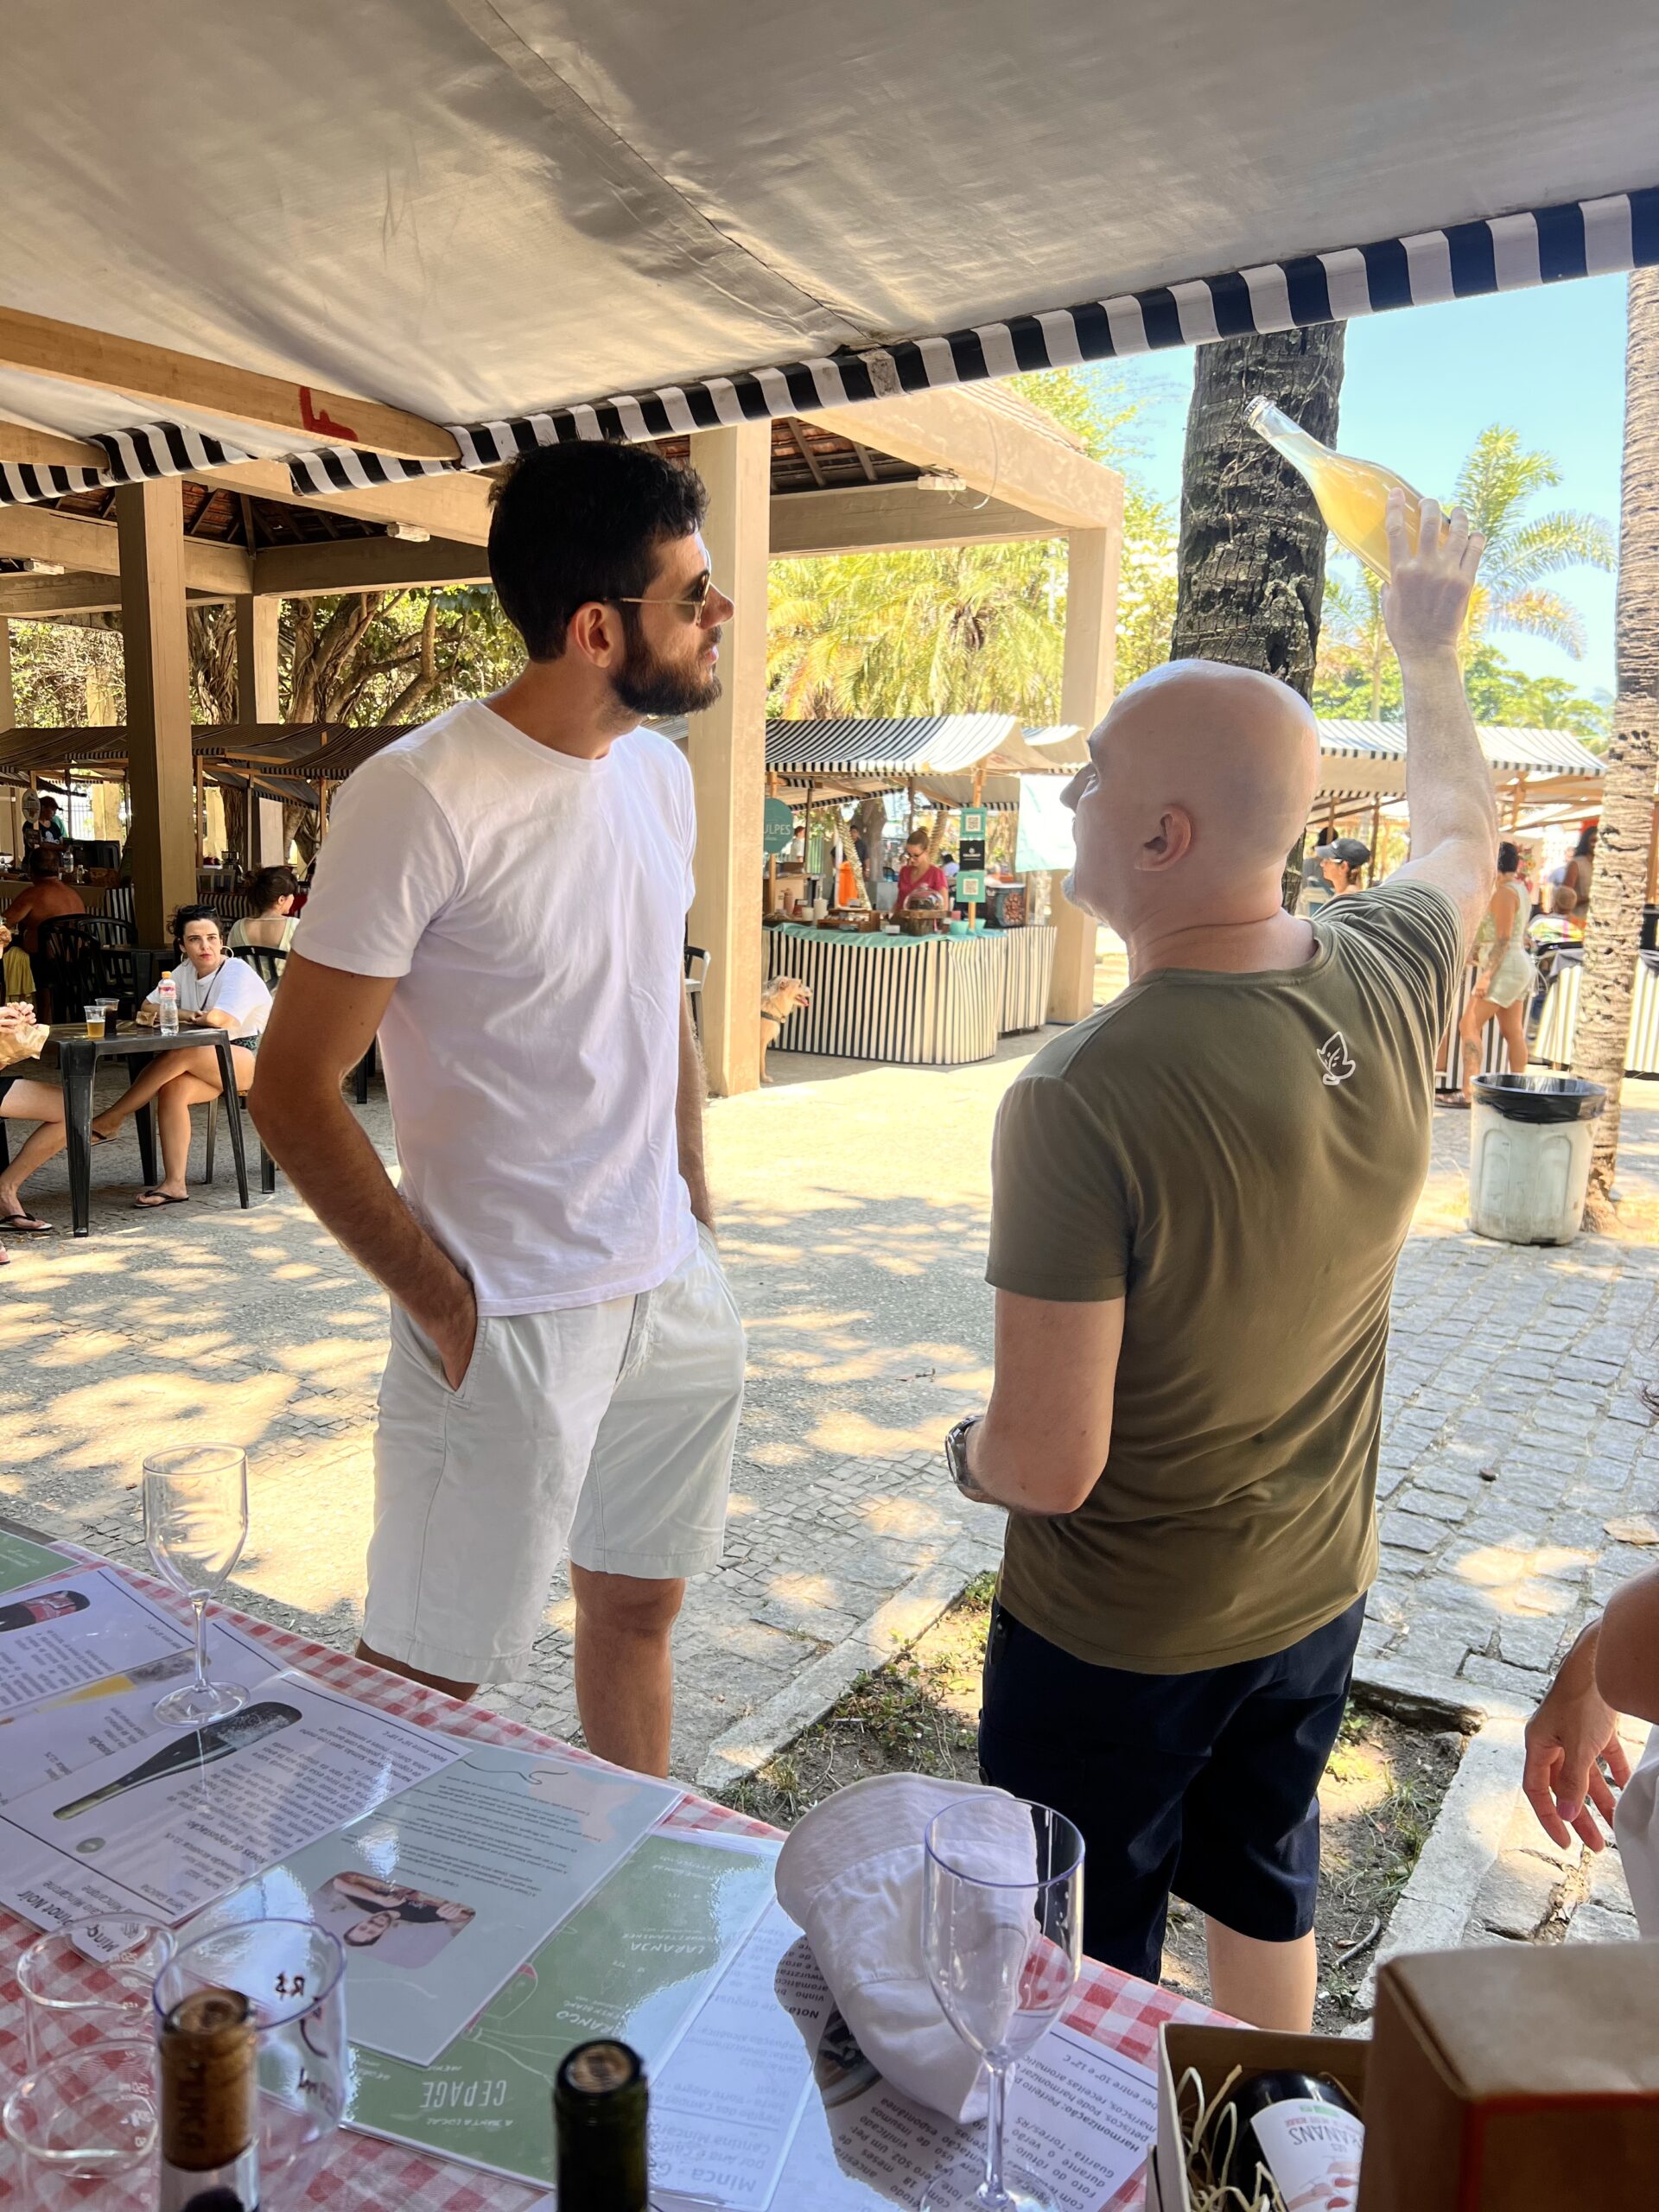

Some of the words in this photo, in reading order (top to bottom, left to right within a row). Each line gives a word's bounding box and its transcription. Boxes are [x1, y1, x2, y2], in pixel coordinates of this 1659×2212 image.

[764, 823, 791, 836] ULPES
[228, 1842, 245, 1853] de
[238, 1847, 269, 1865] Notas
[15, 1888, 48, 1910] Noir
[629, 1941, 704, 1955] LARANJA
[1020, 2054, 1068, 2082] aromátic
[419, 2075, 506, 2112] CEPAGE
[1017, 2067, 1077, 2102] harmonizar
[1019, 2080, 1063, 2107] Perfeito
[1064, 2077, 1108, 2106] receitas
[1109, 2080, 1141, 2100] entre
[875, 2096, 942, 2137] espontânea
[1074, 2097, 1103, 2116] Pode
[855, 2114, 912, 2149] vinificado
[864, 2106, 915, 2137] insumos
[1011, 2114, 1069, 2150] Torres/RS
[1056, 2101, 1143, 2153] Harmonização:
[833, 2133, 853, 2148] de
[912, 2134, 931, 2149] de
[1008, 2127, 1044, 2150] verão
[856, 2148, 897, 2174] meses
[931, 2146, 955, 2163] uso
[1071, 2150, 1116, 2179] Guarita
[689, 2167, 757, 2193] Minca
[1050, 2167, 1068, 2182] do
[1058, 2157, 1108, 2189] durante
[887, 2183, 925, 2208] étodo
[1068, 2178, 1097, 2199] Foto
